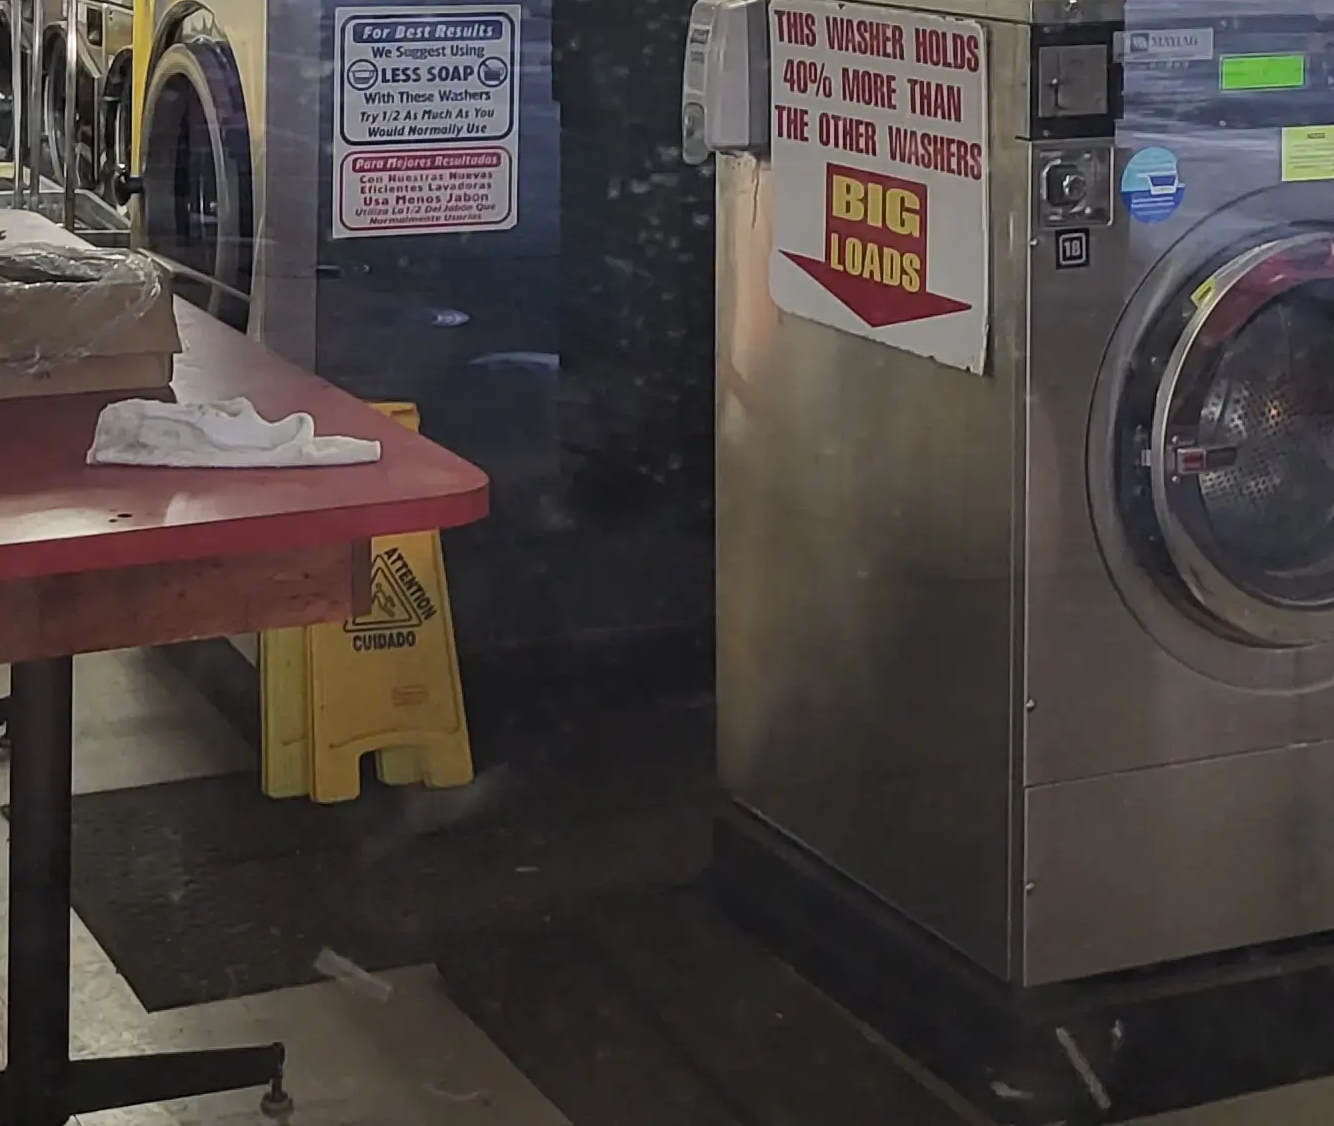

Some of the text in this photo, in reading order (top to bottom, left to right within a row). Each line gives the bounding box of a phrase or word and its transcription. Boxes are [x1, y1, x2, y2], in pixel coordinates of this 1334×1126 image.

[362, 23, 494, 40] For Best Results
[774, 10, 979, 72] THIS WASHER HOLDS
[371, 44, 485, 60] We Suggest Using
[381, 65, 475, 83] LESS SOAP
[363, 89, 491, 104] With These Washers
[783, 59, 962, 122] 40% MORE THAN
[360, 107, 494, 124] Try 1/2 As Much As You
[367, 123, 487, 138] Would Normally Use
[775, 105, 982, 181] THE OTHER WASHERS
[355, 154, 497, 170] Para Mejores Resultados
[360, 171, 493, 184] Con Nuestras Nuevas
[360, 181, 492, 195] Eficientes Lavadoras
[363, 196, 389, 207] Usa
[395, 194, 441, 205] Menos
[831, 174, 921, 238] BIG
[830, 233, 920, 292] LOADS
[384, 547, 437, 620] ATTENTION
[352, 631, 417, 651] CUIDADO
